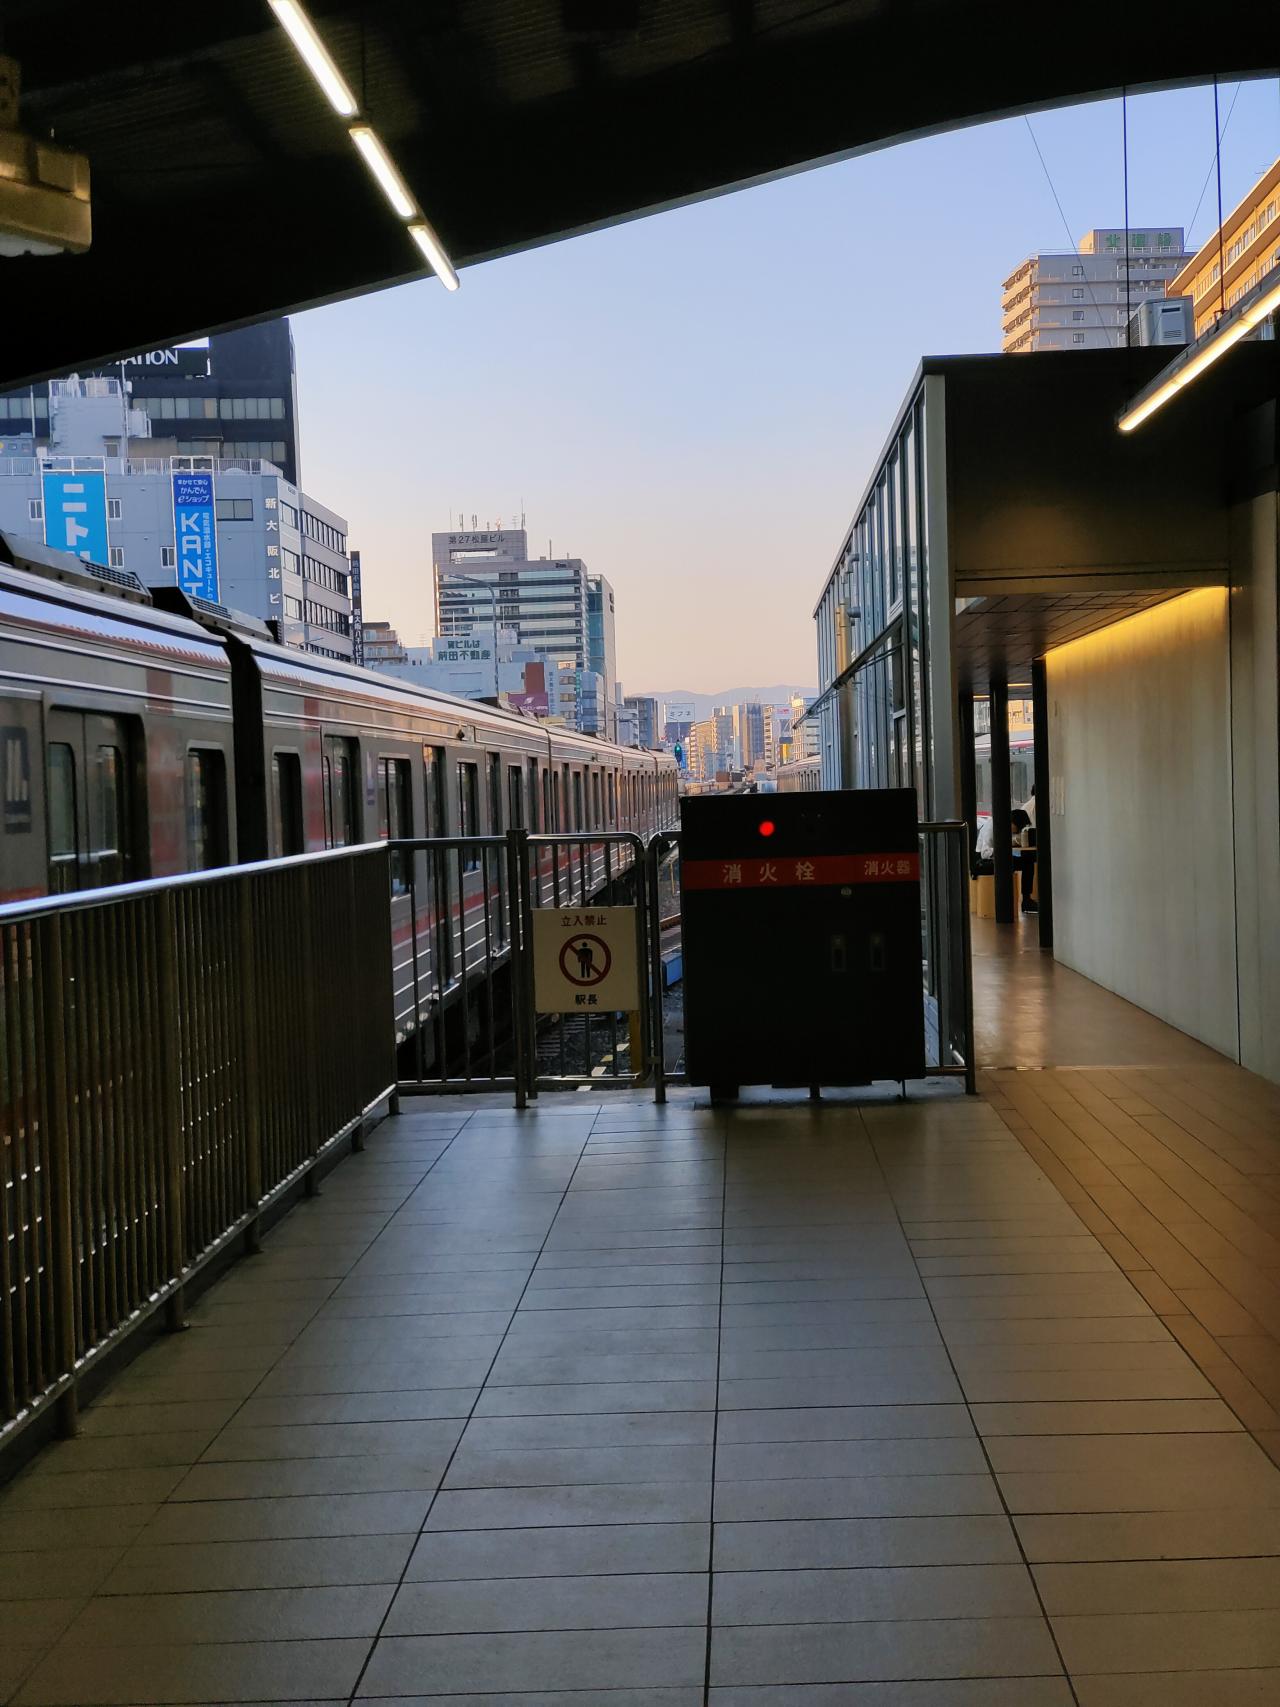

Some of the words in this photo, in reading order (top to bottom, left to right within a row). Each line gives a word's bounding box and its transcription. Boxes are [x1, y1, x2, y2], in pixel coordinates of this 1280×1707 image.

[264, 498, 280, 621] 新大阪北ビ
[722, 861, 816, 884] 消火栓
[863, 859, 911, 876] 消火器
[560, 914, 608, 927] 立入禁止
[575, 993, 598, 1006] 駅長
